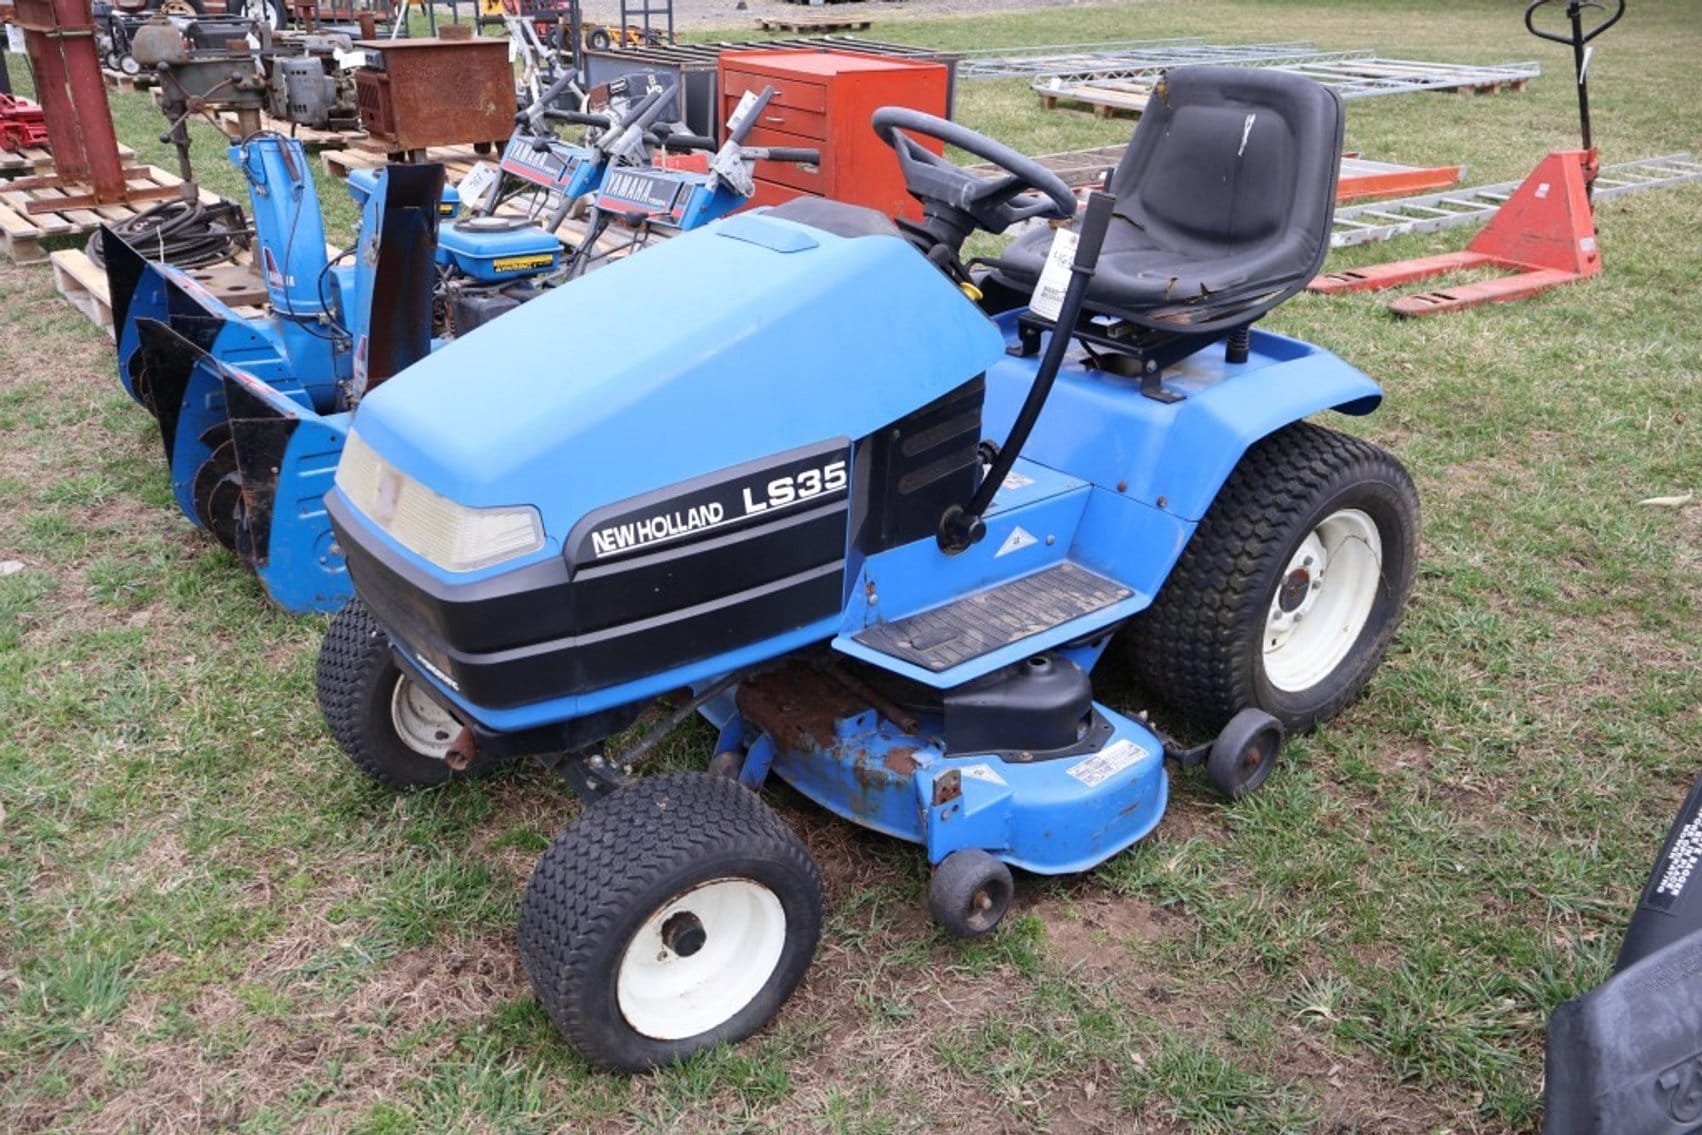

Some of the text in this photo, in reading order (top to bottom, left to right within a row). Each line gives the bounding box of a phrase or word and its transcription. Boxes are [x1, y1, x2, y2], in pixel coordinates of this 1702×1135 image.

[509, 141, 548, 170] YAMAHA
[605, 171, 653, 201] YAMAHA
[592, 461, 847, 554] NEW HOLLAND LS35
[1656, 839, 1690, 893] OPERATING
[1670, 855, 1698, 896] BAGGER
